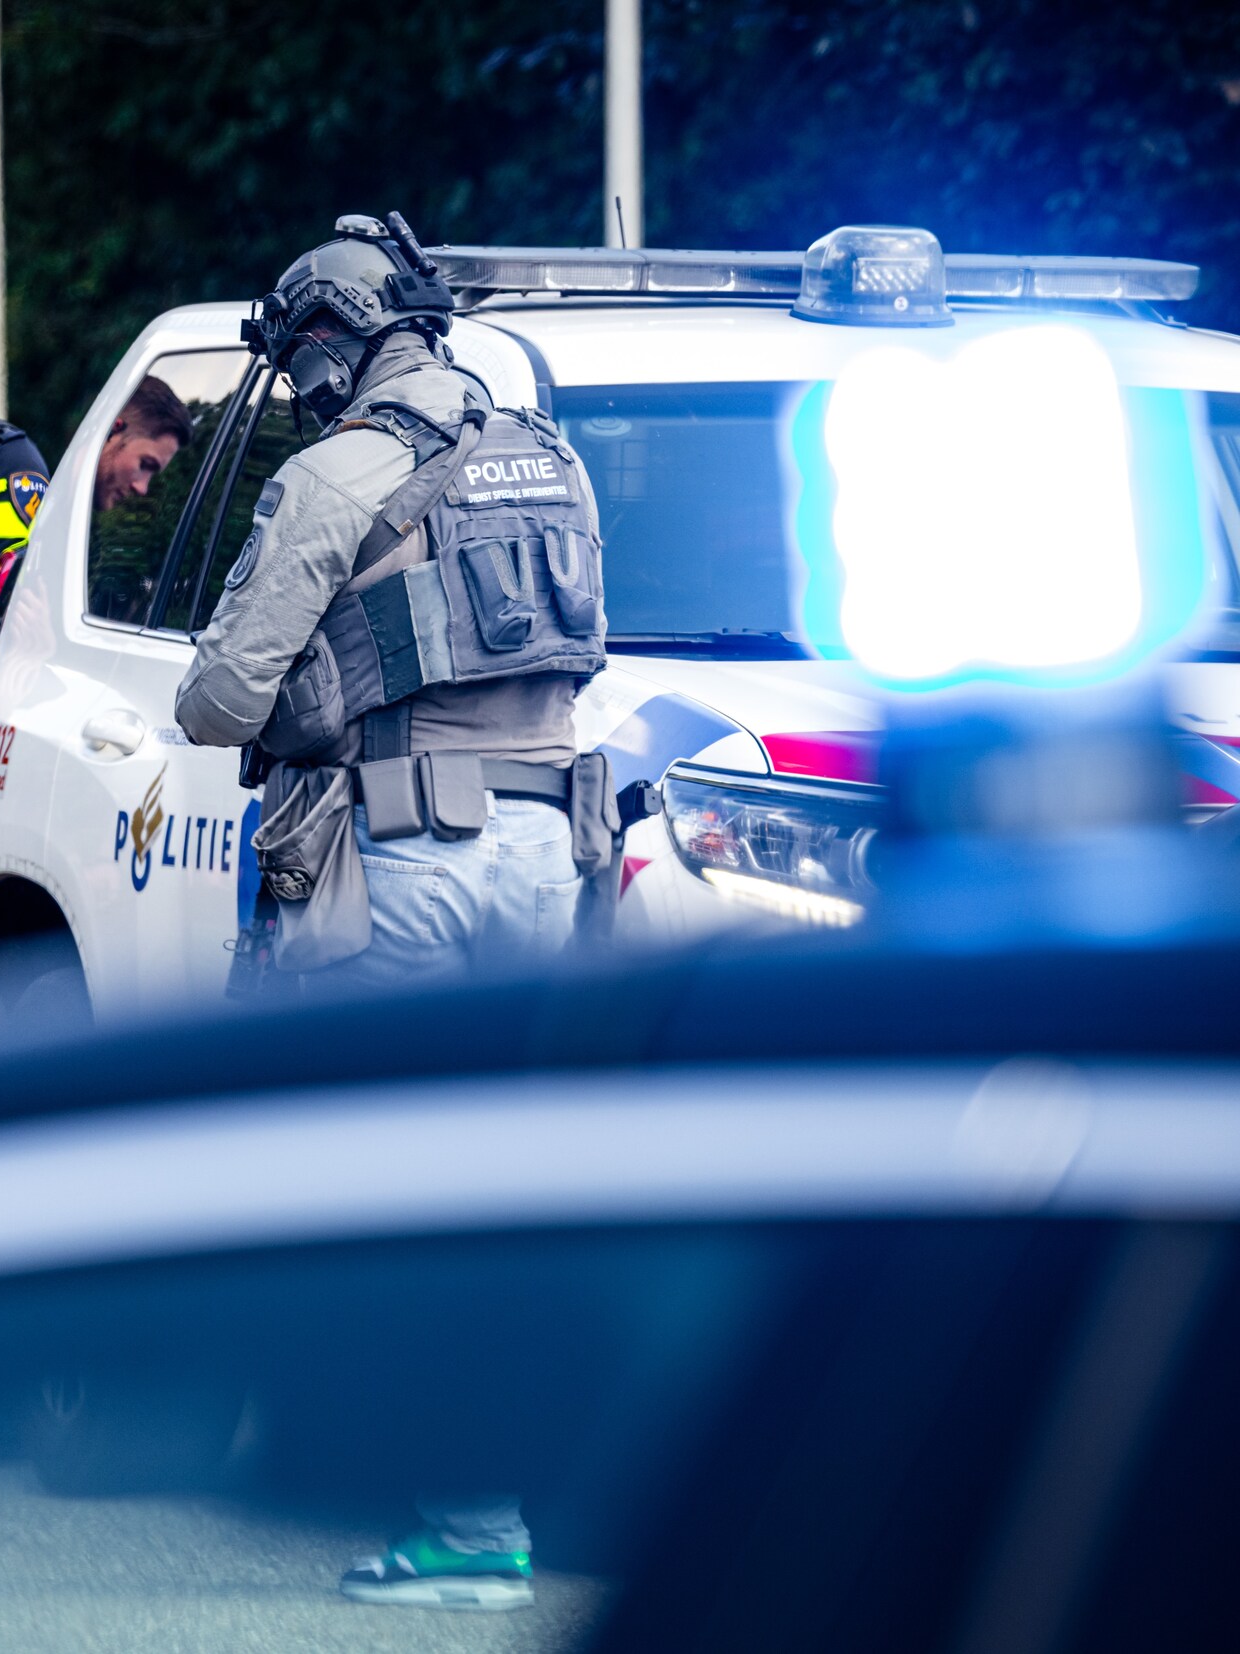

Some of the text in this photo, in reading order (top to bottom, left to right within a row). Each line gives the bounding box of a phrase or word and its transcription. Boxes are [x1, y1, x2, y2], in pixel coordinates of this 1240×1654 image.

[14, 479, 47, 493] POLITI
[464, 458, 557, 486] POLITIE
[114, 810, 234, 892] POLITIE
